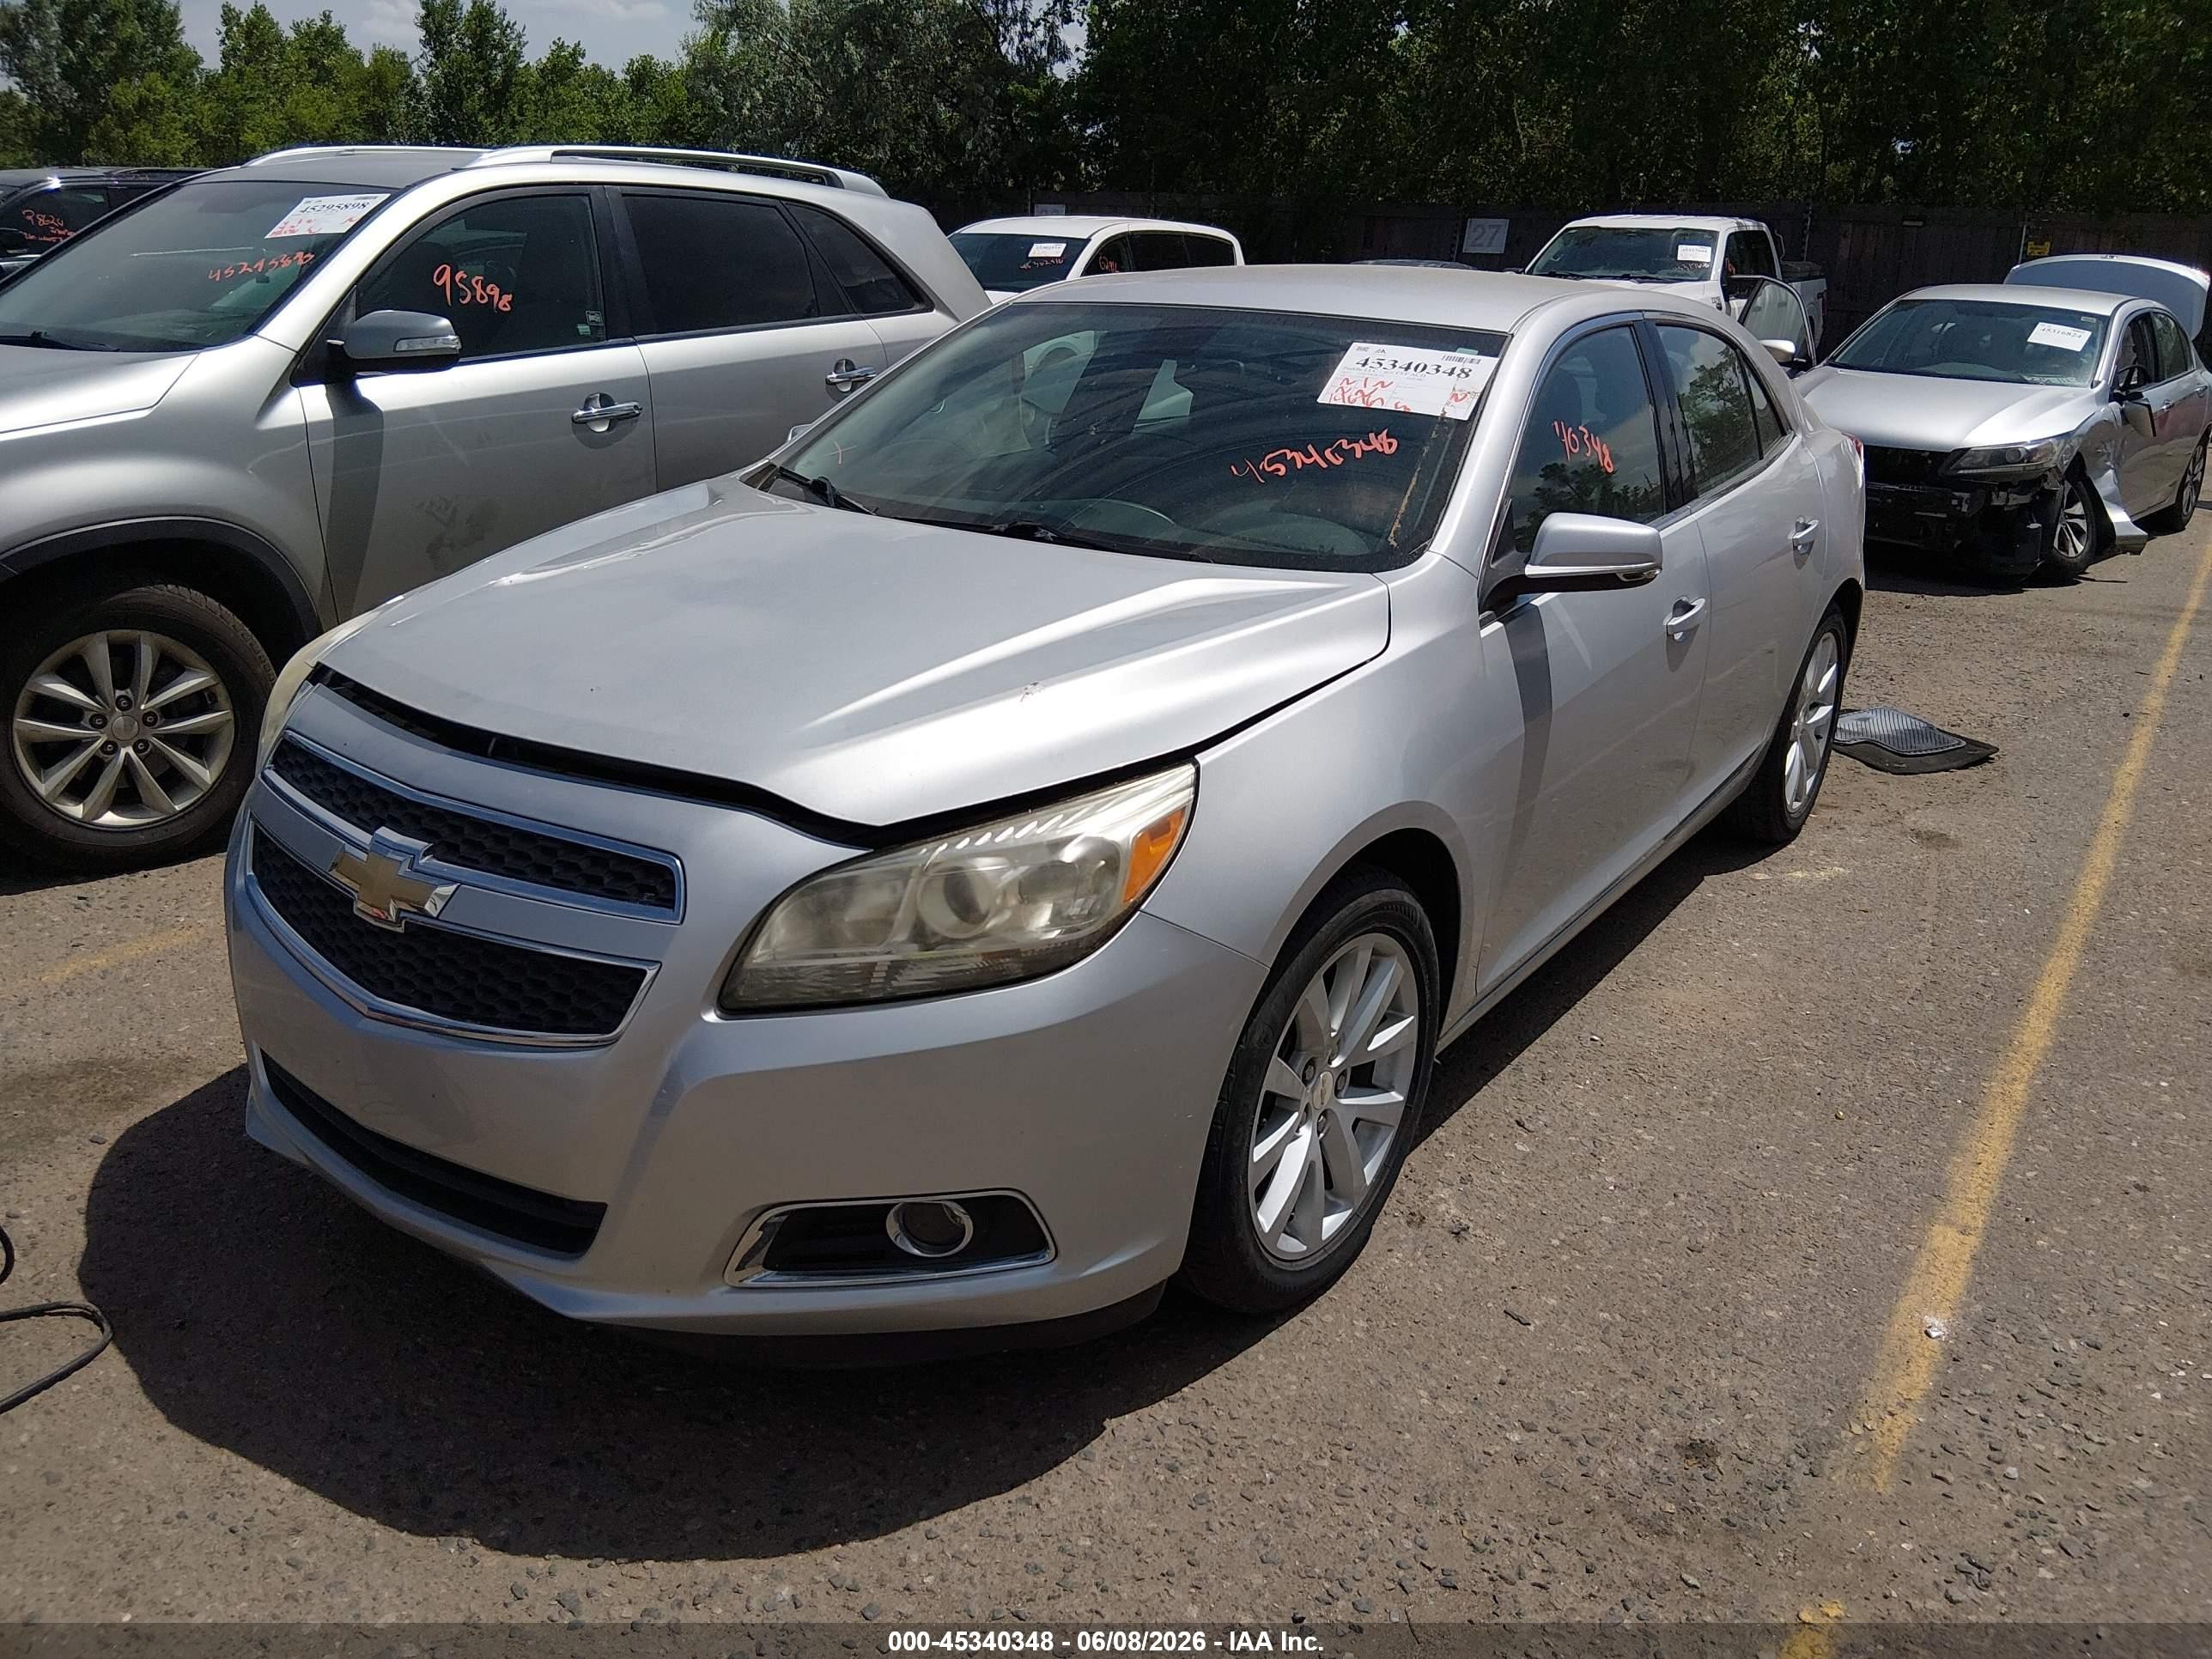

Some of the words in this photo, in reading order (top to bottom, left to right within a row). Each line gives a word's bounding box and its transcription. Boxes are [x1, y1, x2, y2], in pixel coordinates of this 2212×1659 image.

[433, 264, 514, 312] 95898
[1355, 356, 1473, 380] 45340348
[1231, 428, 1399, 483] 45340348
